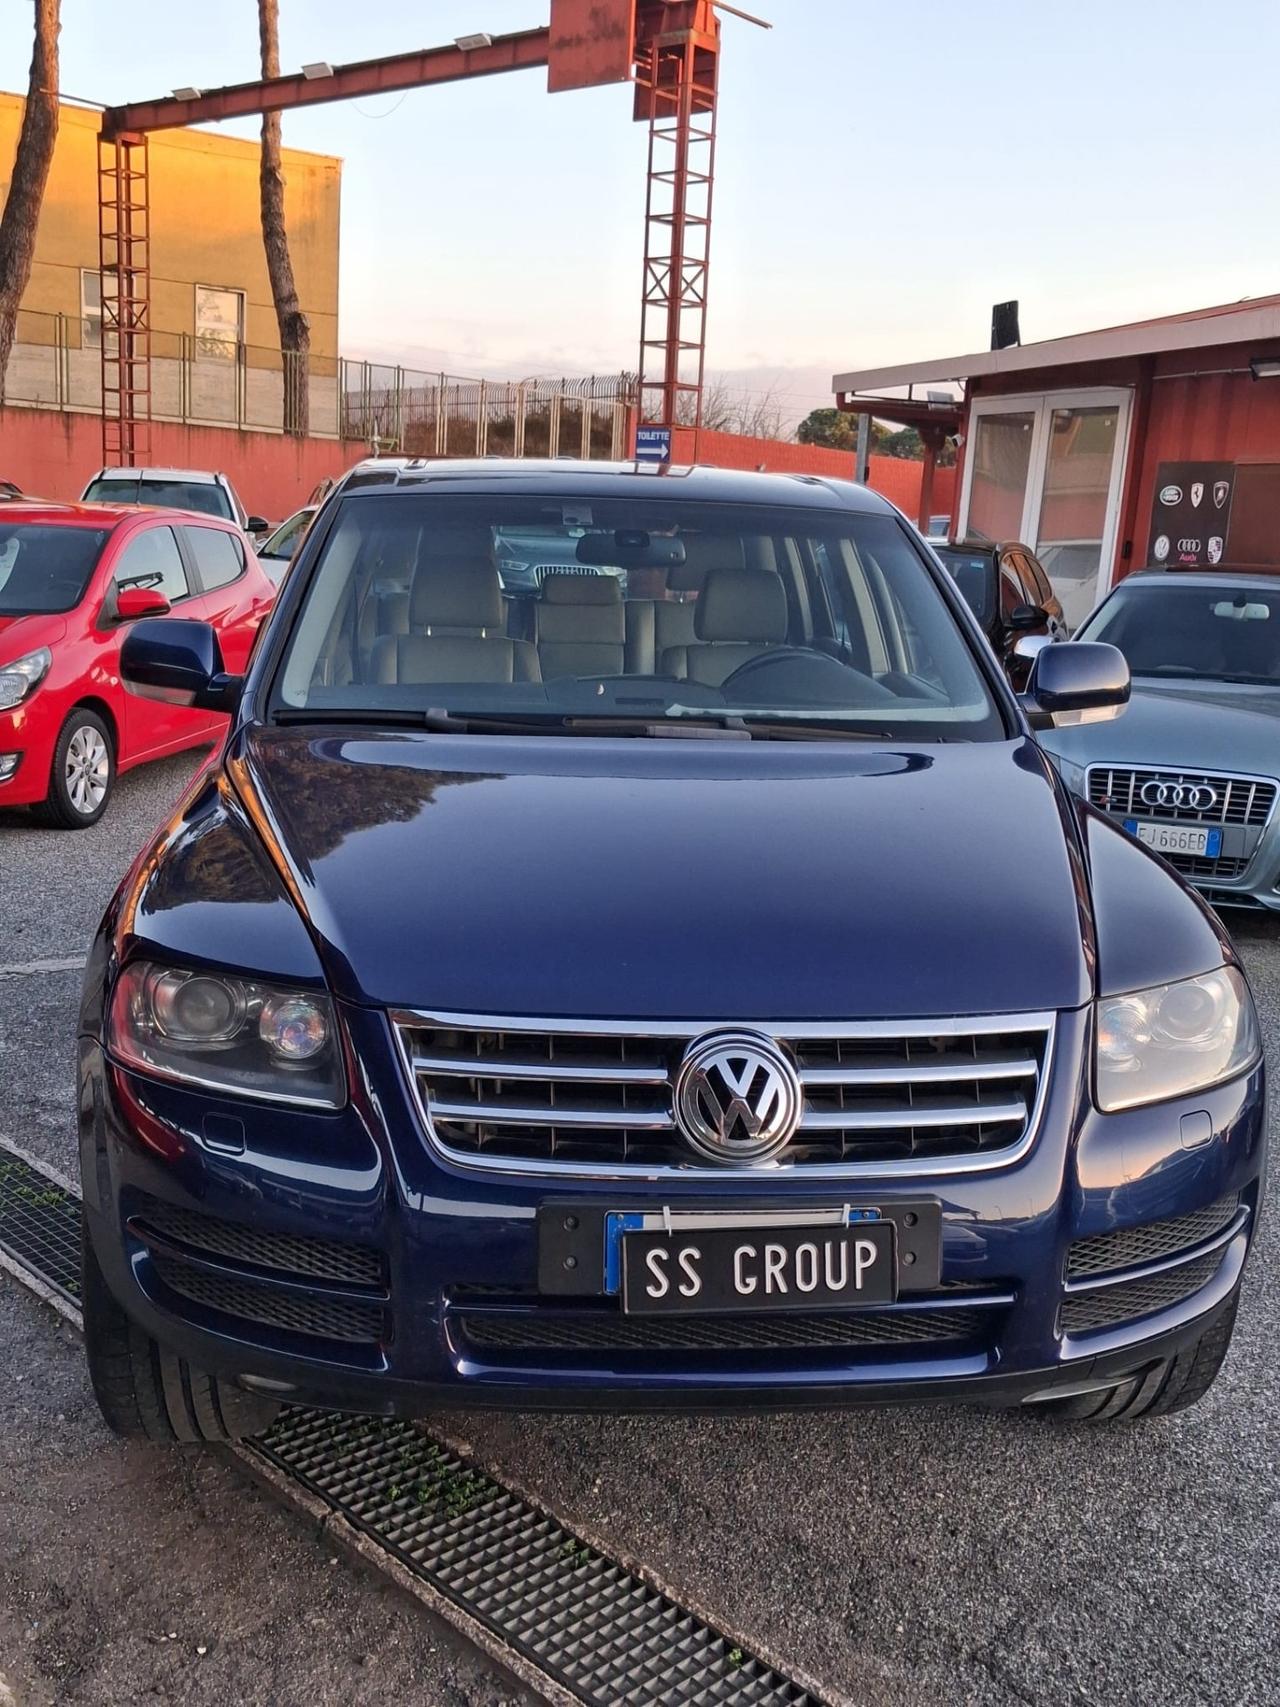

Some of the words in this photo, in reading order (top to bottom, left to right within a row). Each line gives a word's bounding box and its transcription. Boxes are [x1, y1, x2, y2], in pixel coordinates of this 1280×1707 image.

[637, 431, 669, 440] TOILETTE
[645, 1246, 702, 1299] SS
[733, 1240, 878, 1295] GROUP
